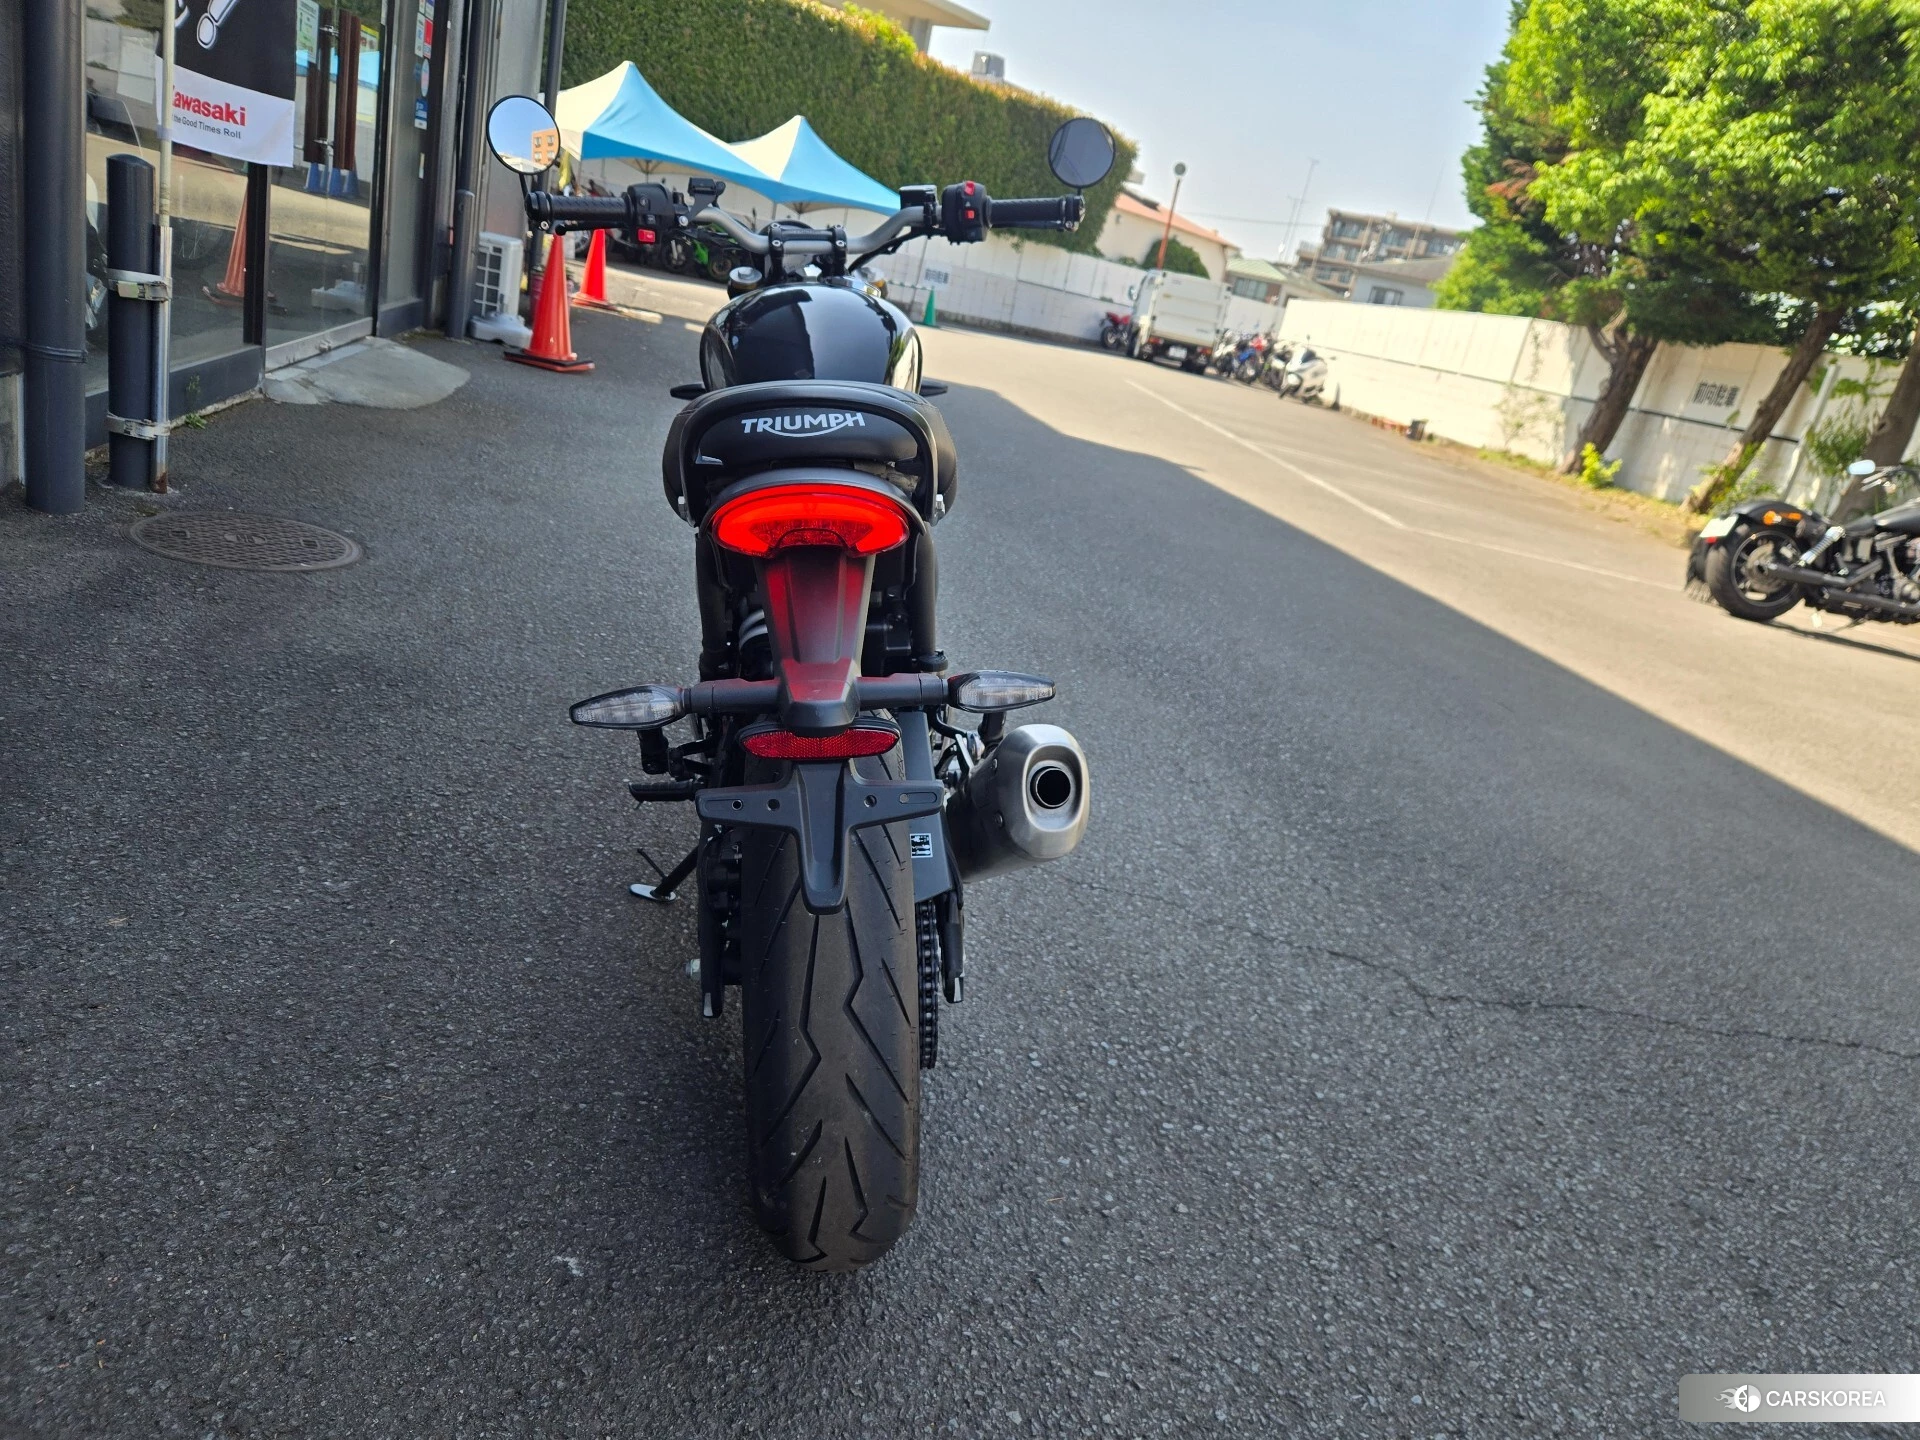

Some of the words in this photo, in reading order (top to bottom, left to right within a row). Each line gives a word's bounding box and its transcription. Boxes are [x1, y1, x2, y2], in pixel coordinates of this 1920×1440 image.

[172, 85, 246, 127] awasaki
[181, 116, 198, 129] Good
[198, 120, 221, 135] Times
[223, 127, 242, 140] Roll
[741, 412, 866, 438] TRIUMPH
